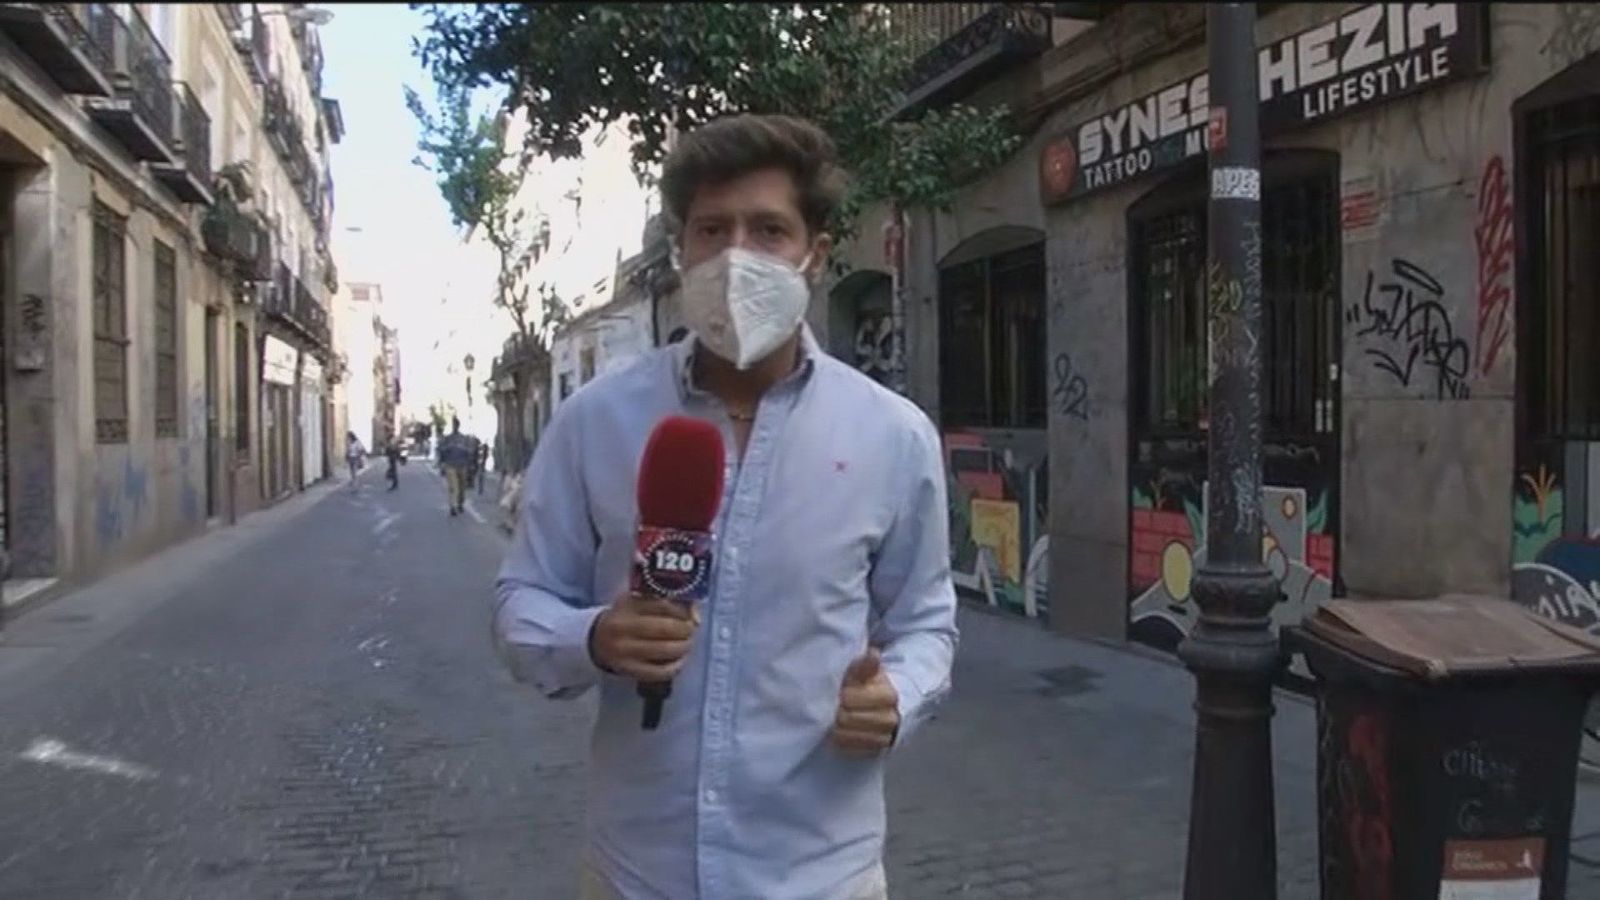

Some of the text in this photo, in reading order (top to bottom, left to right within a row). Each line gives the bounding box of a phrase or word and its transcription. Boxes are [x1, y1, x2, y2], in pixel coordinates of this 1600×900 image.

[1084, 148, 1151, 189] TATTOO
[1303, 46, 1449, 119] LIFESTYLE
[656, 549, 694, 572] 120
